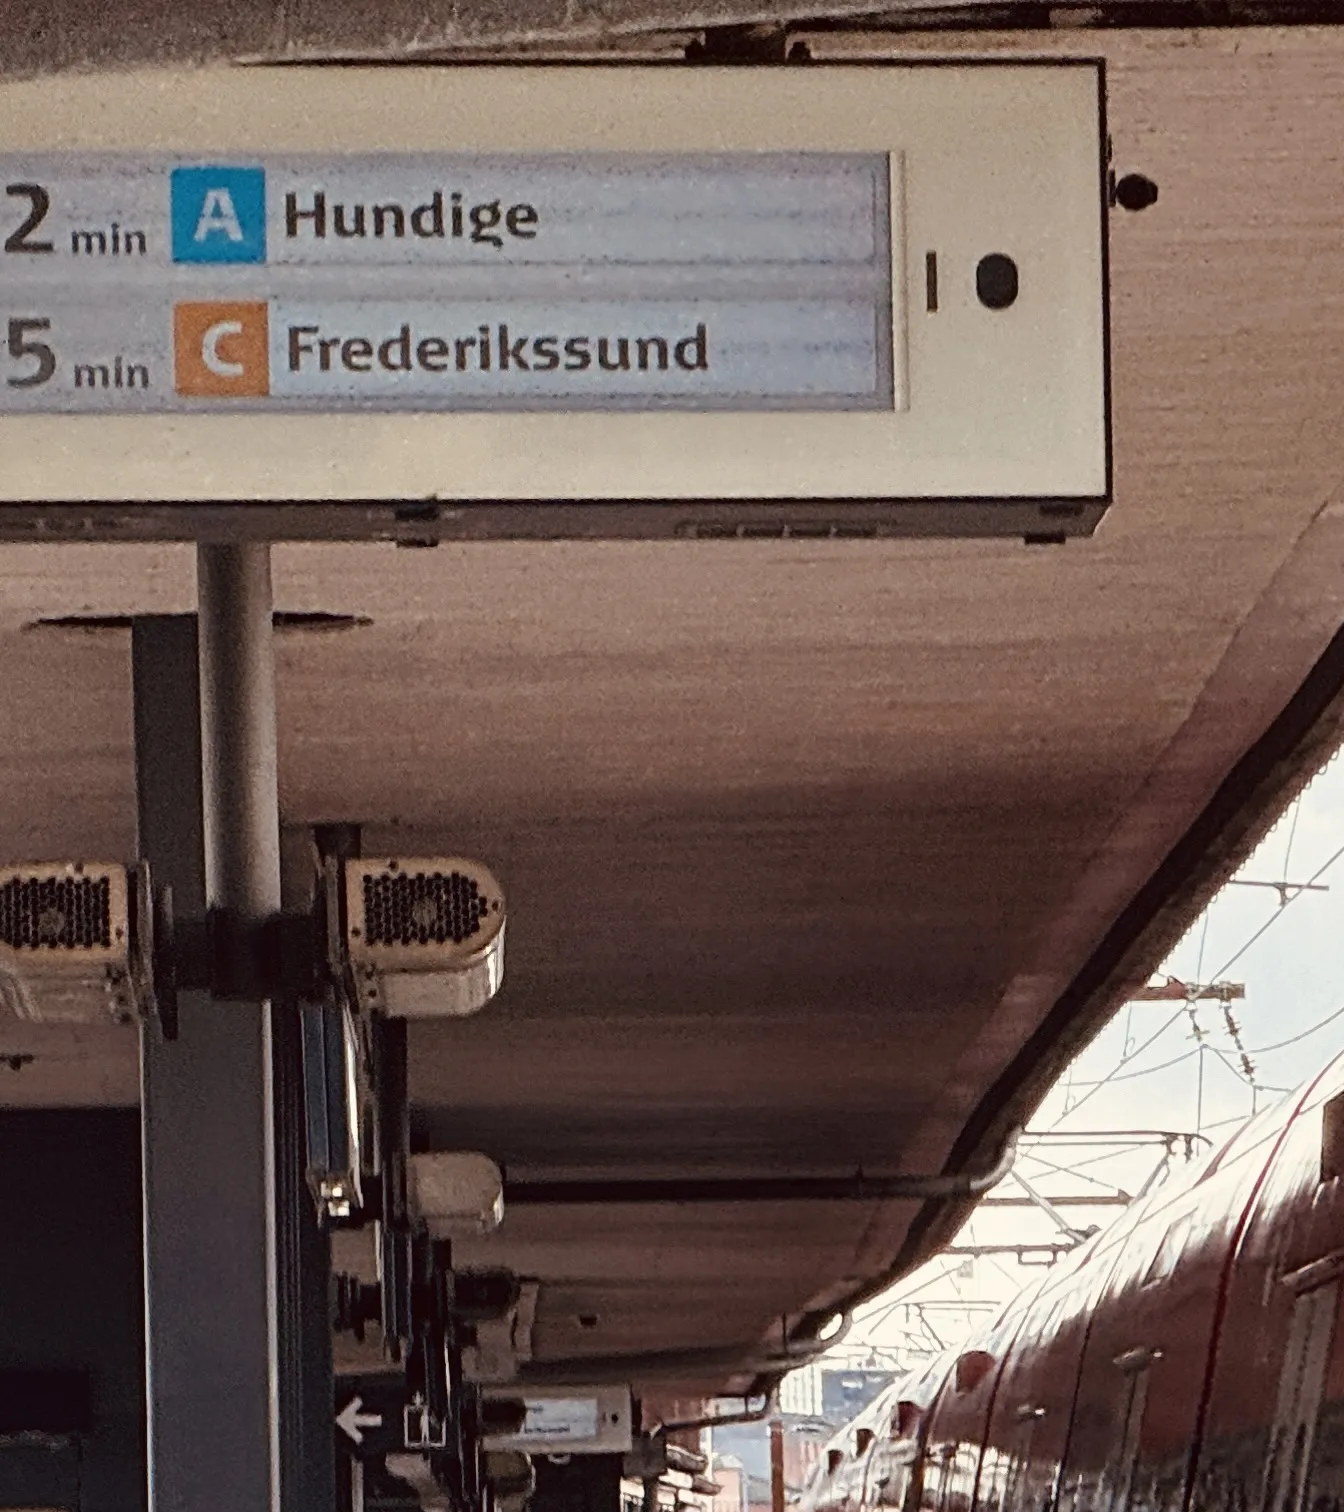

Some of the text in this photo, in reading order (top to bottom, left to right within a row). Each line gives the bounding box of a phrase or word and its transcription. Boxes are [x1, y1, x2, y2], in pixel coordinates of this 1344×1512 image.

[5, 182, 540, 254] 2 min A Hundige
[6, 316, 709, 389] 5 min C Frederikssund
